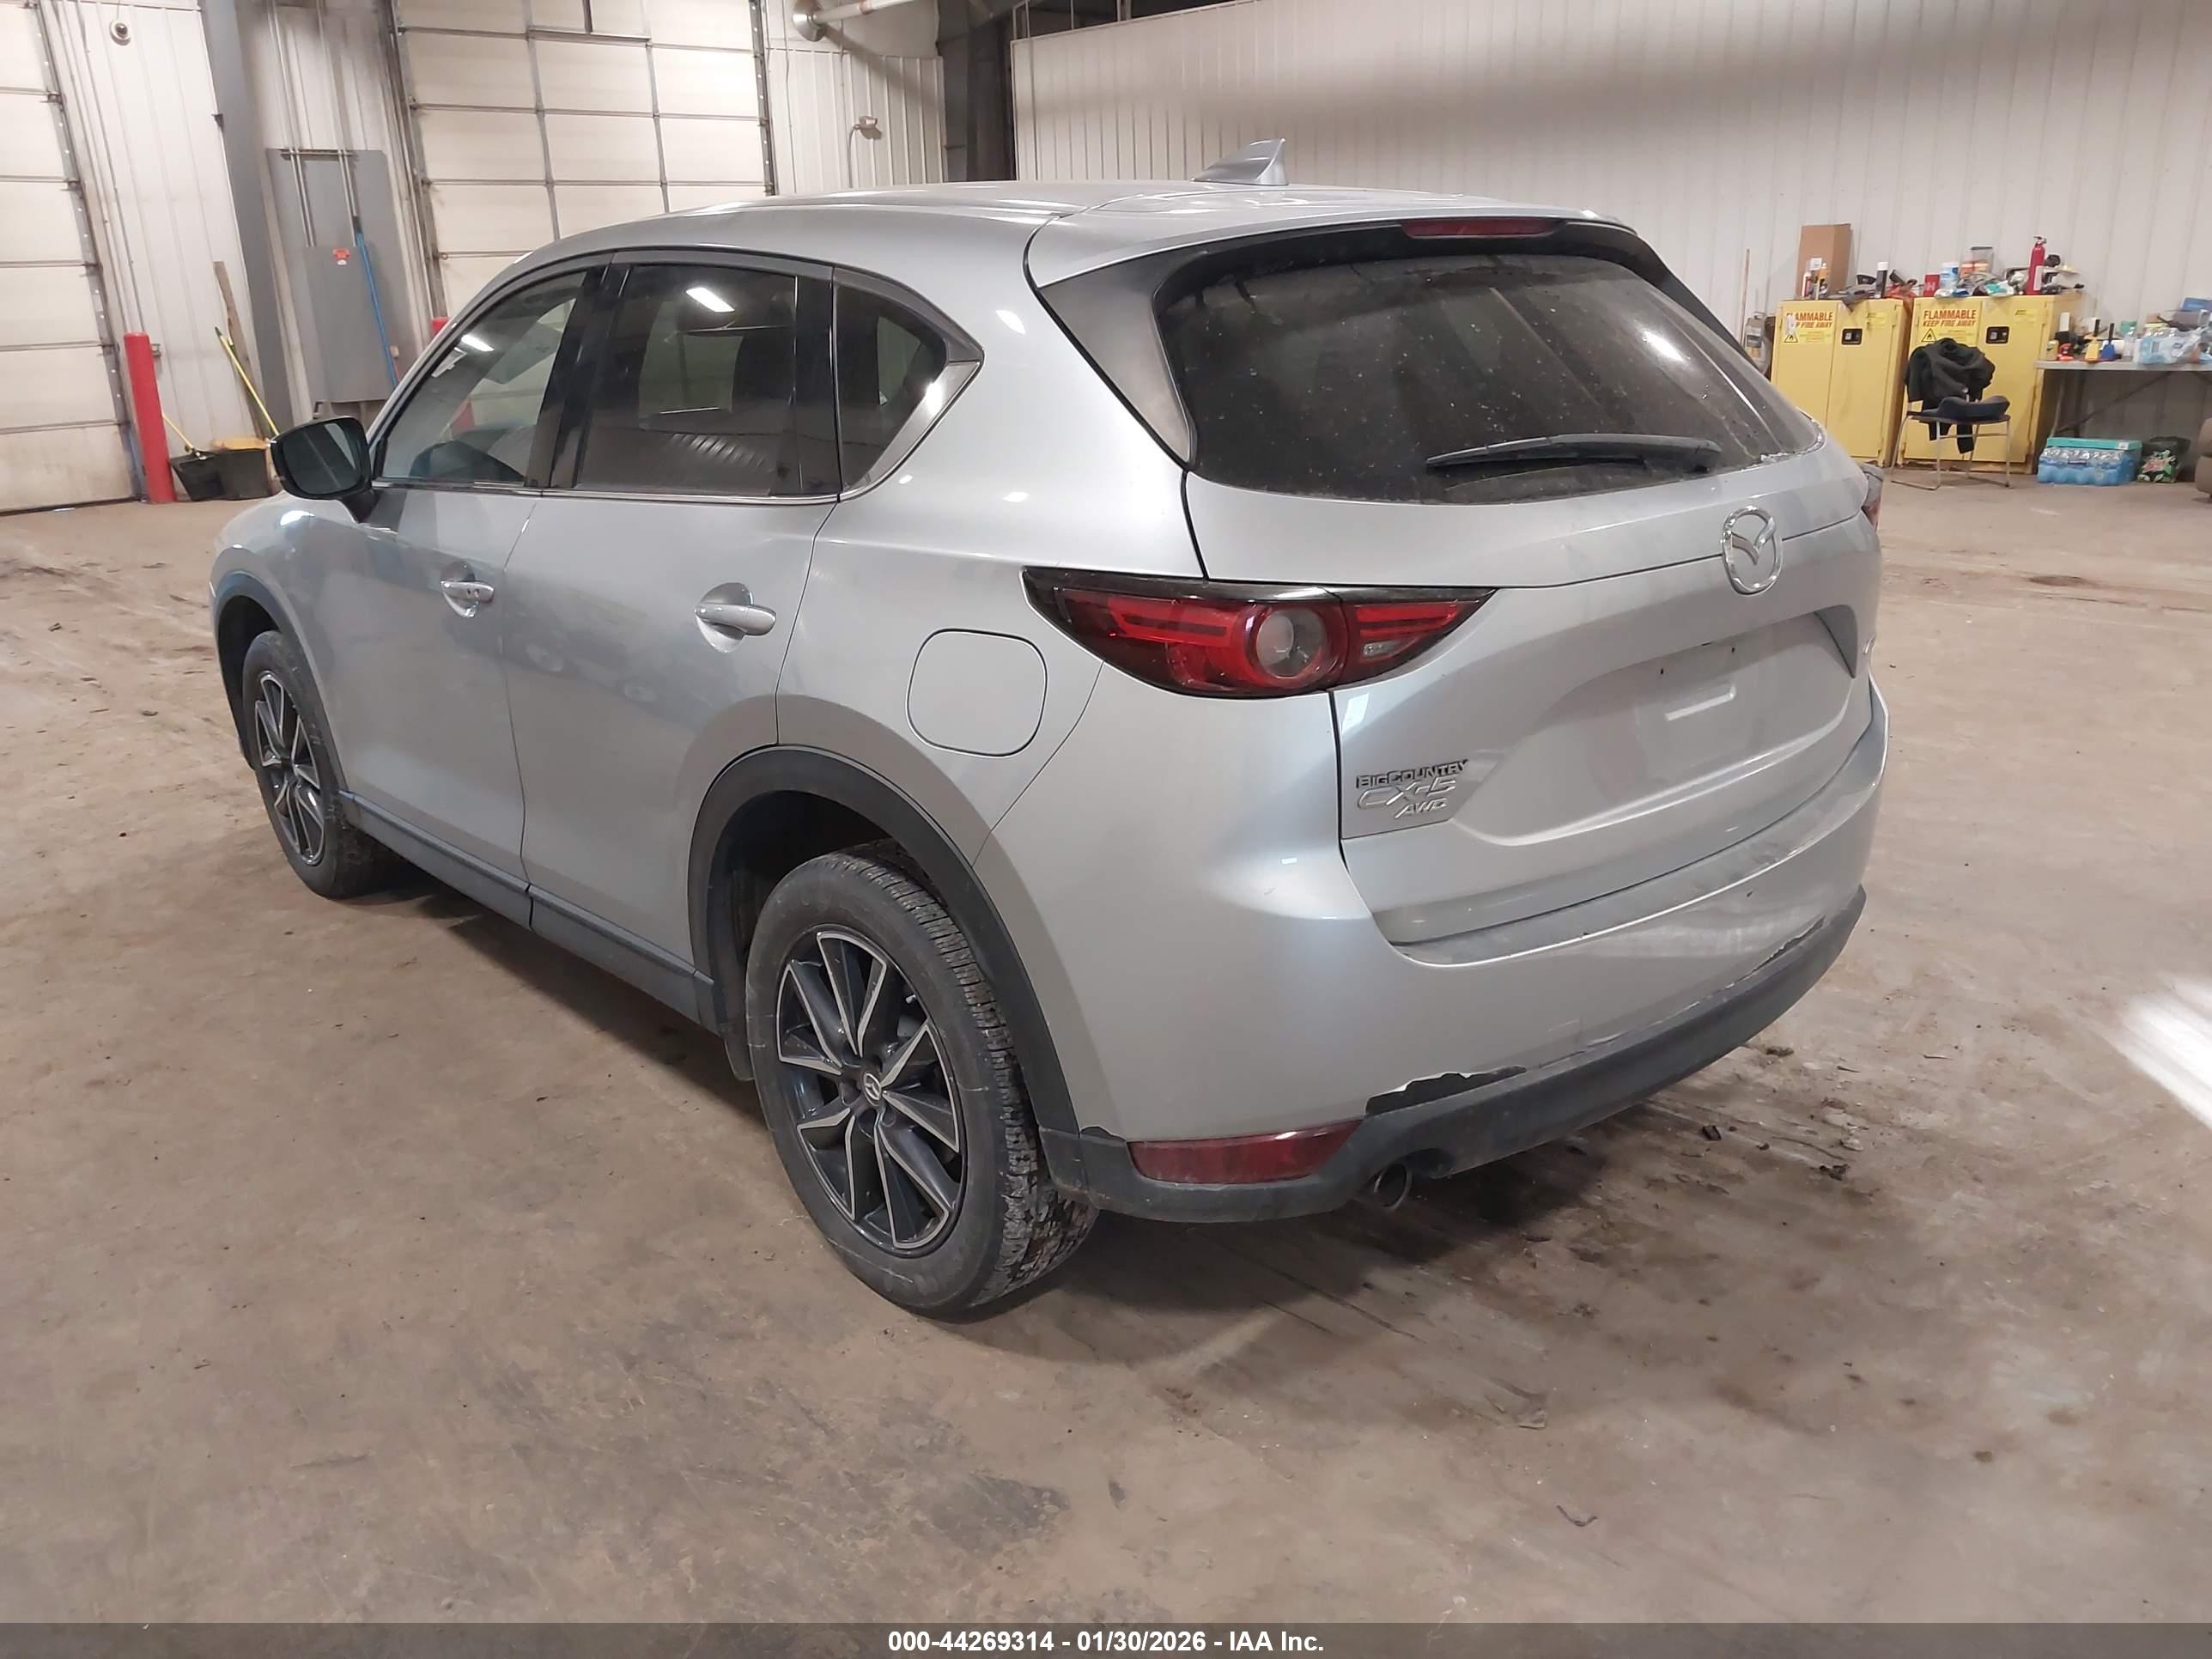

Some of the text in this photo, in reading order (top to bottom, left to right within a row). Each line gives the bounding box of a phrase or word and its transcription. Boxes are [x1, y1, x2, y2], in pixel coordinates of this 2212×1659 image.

[1786, 312, 1833, 321] AMMABLE
[1923, 309, 1977, 319] FLAMMABLE
[1357, 776, 1457, 810] CX-5
[1394, 797, 1448, 819] AWD
